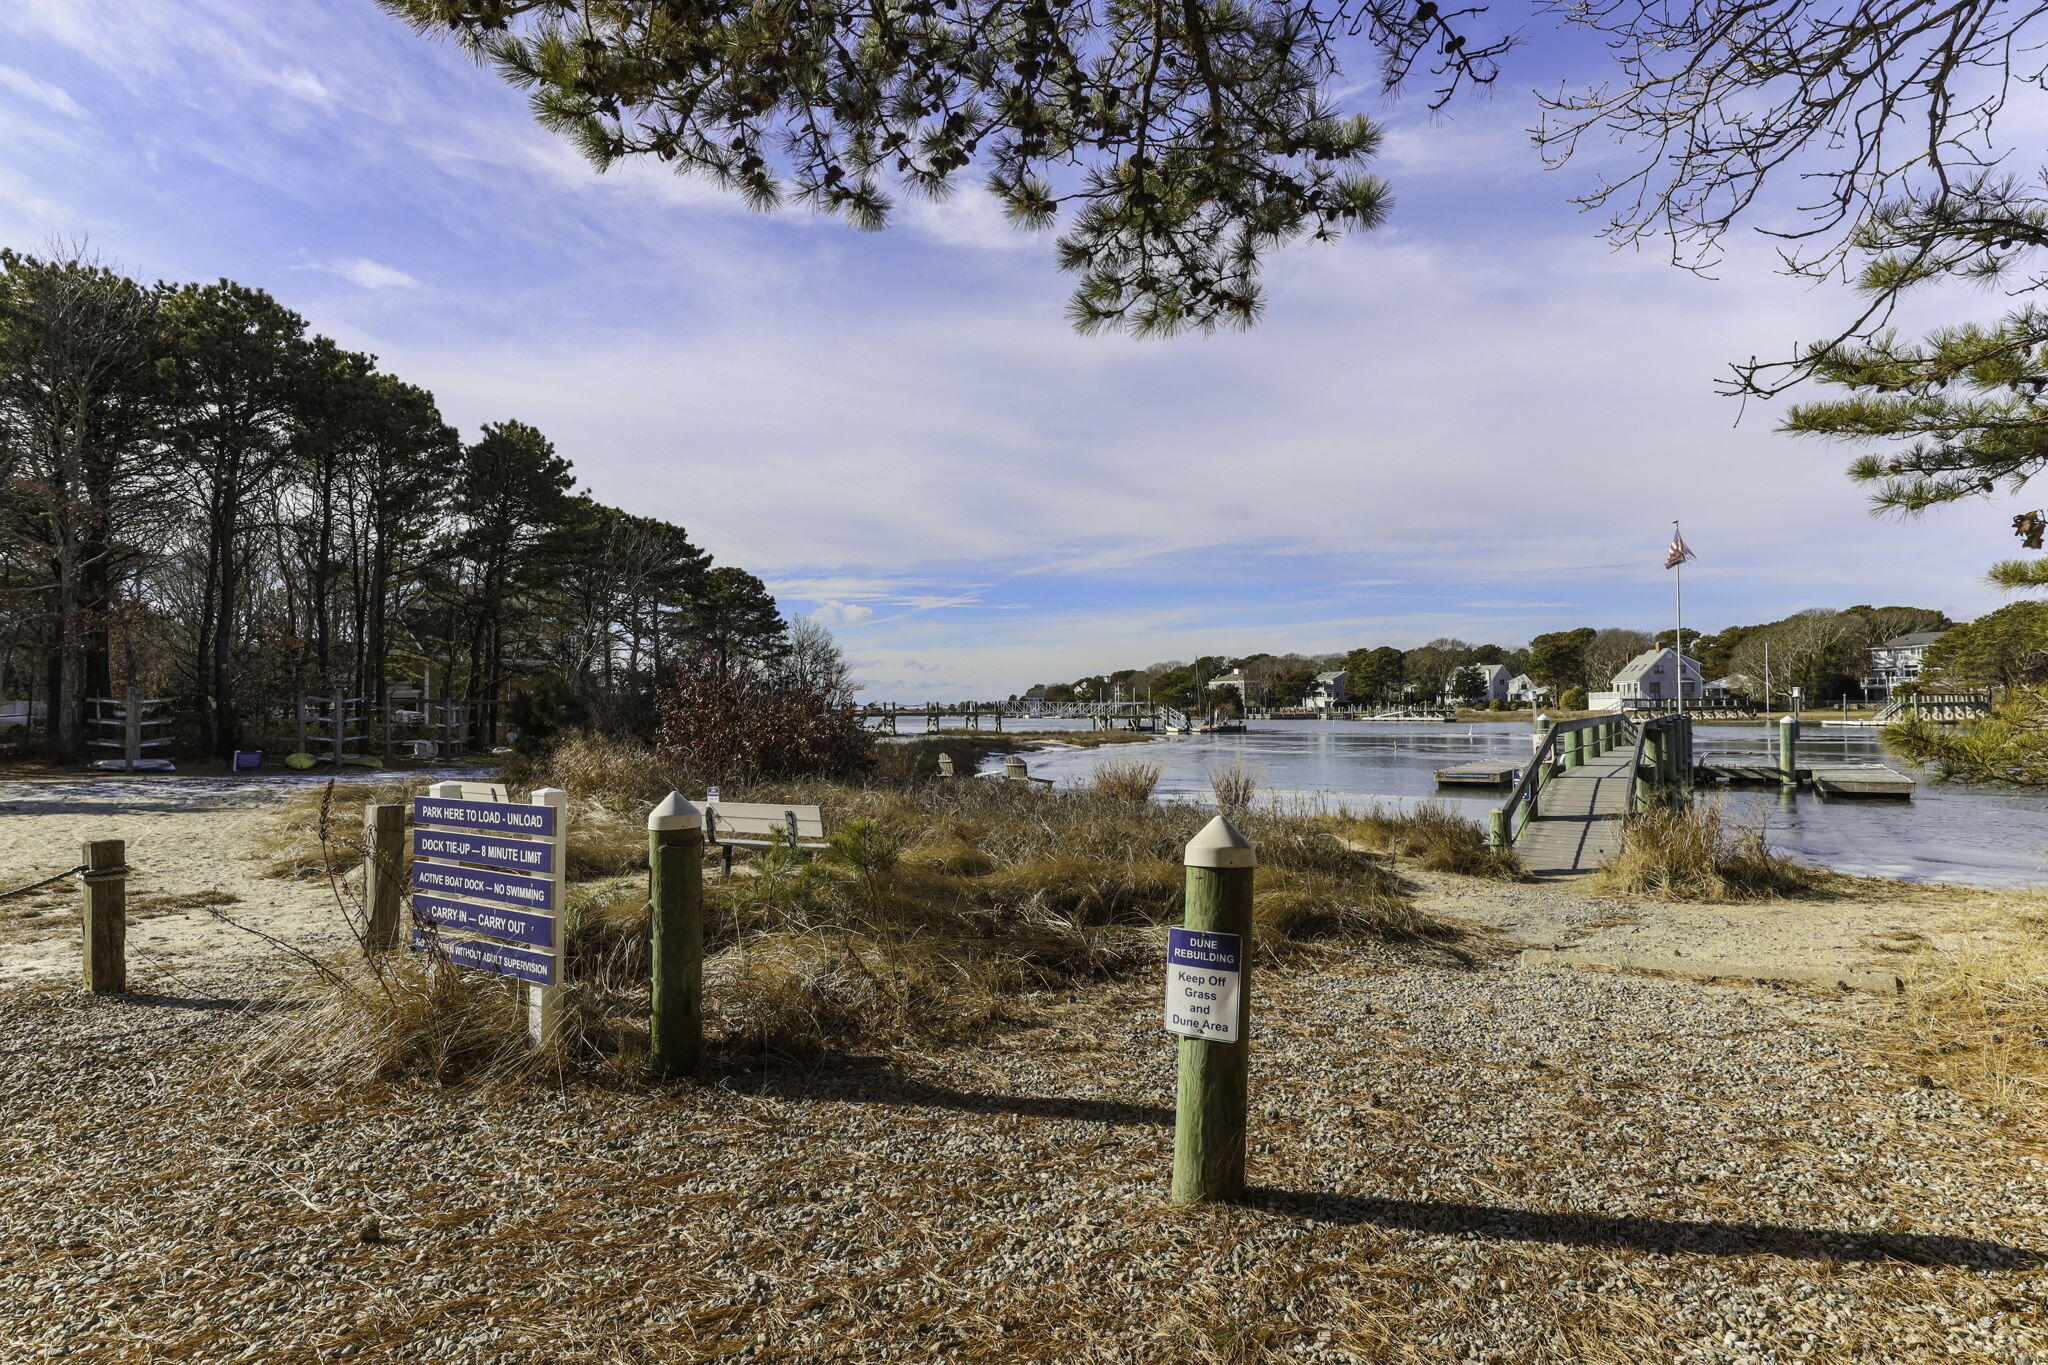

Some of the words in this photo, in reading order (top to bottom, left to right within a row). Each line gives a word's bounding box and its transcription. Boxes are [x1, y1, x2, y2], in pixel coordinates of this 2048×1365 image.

[422, 805, 443, 819] PARK
[443, 807, 465, 821] HERE
[465, 809, 477, 822] TO
[478, 810, 501, 824] LOAD
[507, 812, 543, 828] UNLOAD
[422, 838, 445, 852] DOCK
[445, 840, 471, 855] TIE-UP
[481, 846, 486, 857] 8
[487, 845, 519, 861] MINUTE
[519, 849, 543, 865] LIMIT
[419, 872, 444, 886] ACTIVE
[444, 875, 464, 888] BOAT
[464, 878, 485, 892] DOCK
[493, 883, 505, 895] NO
[505, 884, 545, 902] SWIMMING
[431, 905, 458, 920] CARRY
[459, 909, 467, 923] IN
[478, 913, 506, 931] CARRY
[507, 919, 526, 935] OUT
[1189, 937, 1219, 950] DUNE
[455, 944, 482, 960] WITHOUT
[482, 951, 503, 966] ADULT
[503, 956, 548, 976] SUPERVISION
[1174, 947, 1235, 964] REBUILDING
[1178, 971, 1205, 986] Keep
[1208, 975, 1227, 987] Off
[1184, 987, 1217, 1001] Grass
[1189, 1003, 1210, 1015] and
[1172, 1014, 1200, 1028] Dune
[1202, 1019, 1229, 1032] Area
